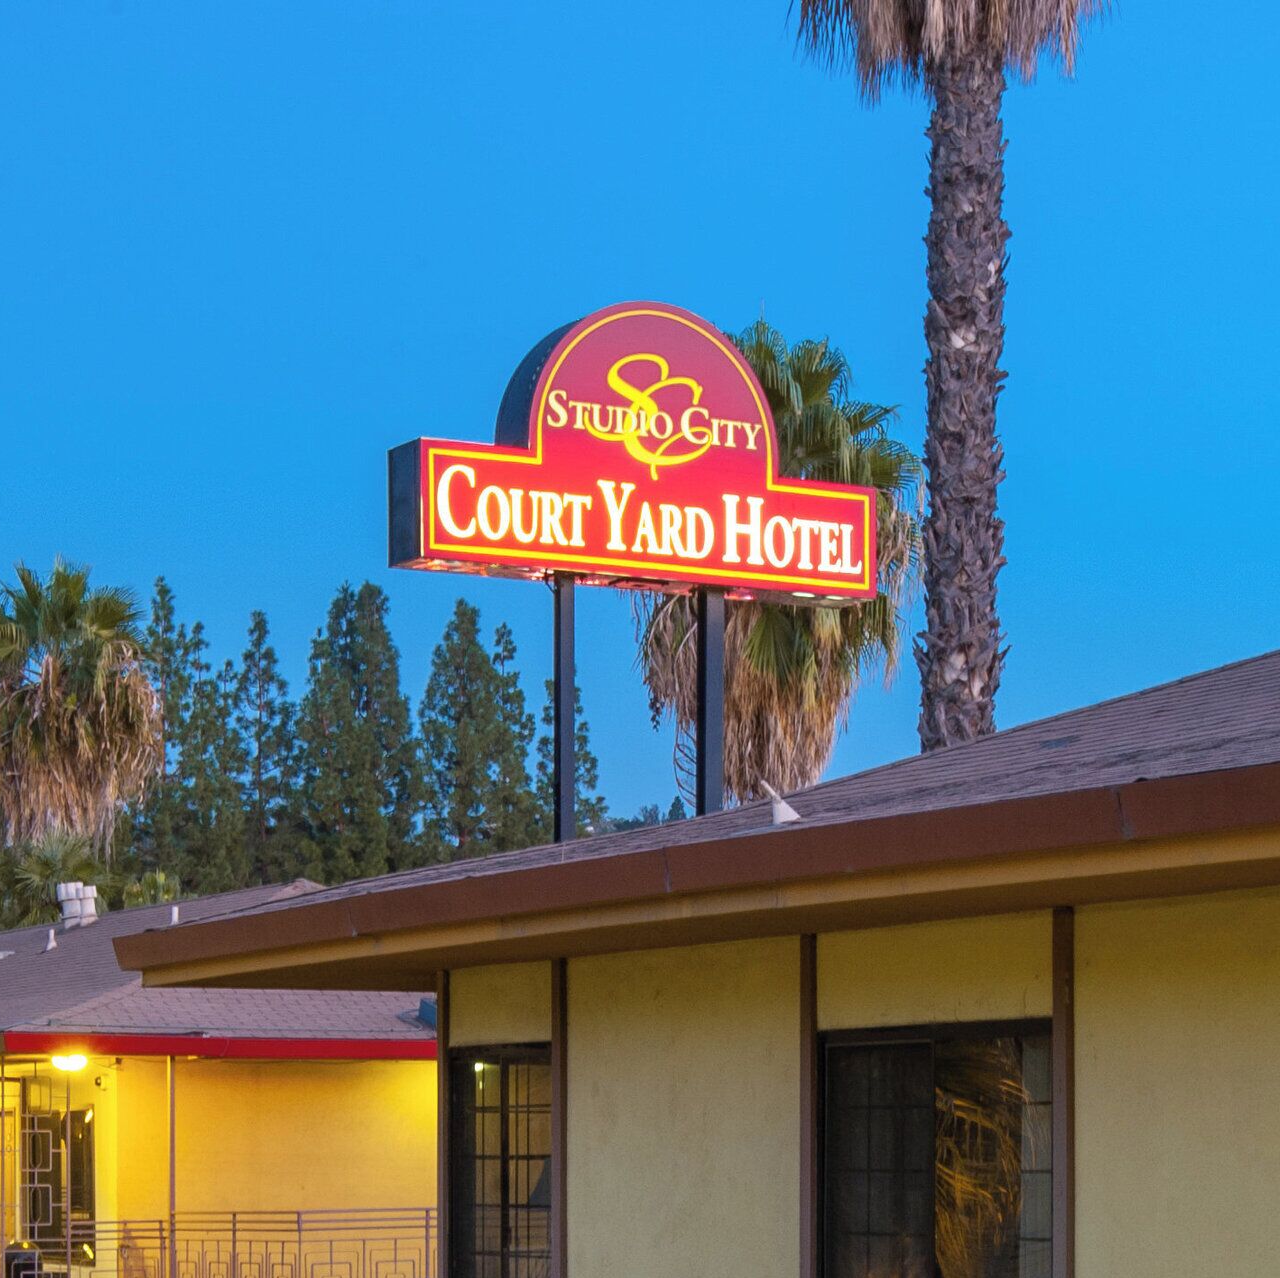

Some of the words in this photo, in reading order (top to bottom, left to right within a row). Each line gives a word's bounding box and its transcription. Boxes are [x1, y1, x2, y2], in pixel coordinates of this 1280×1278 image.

[547, 390, 673, 440] STUDIO
[680, 405, 763, 451] CITY
[436, 465, 592, 548] COURT
[596, 479, 716, 560] YARD
[722, 493, 862, 576] HOTEL
